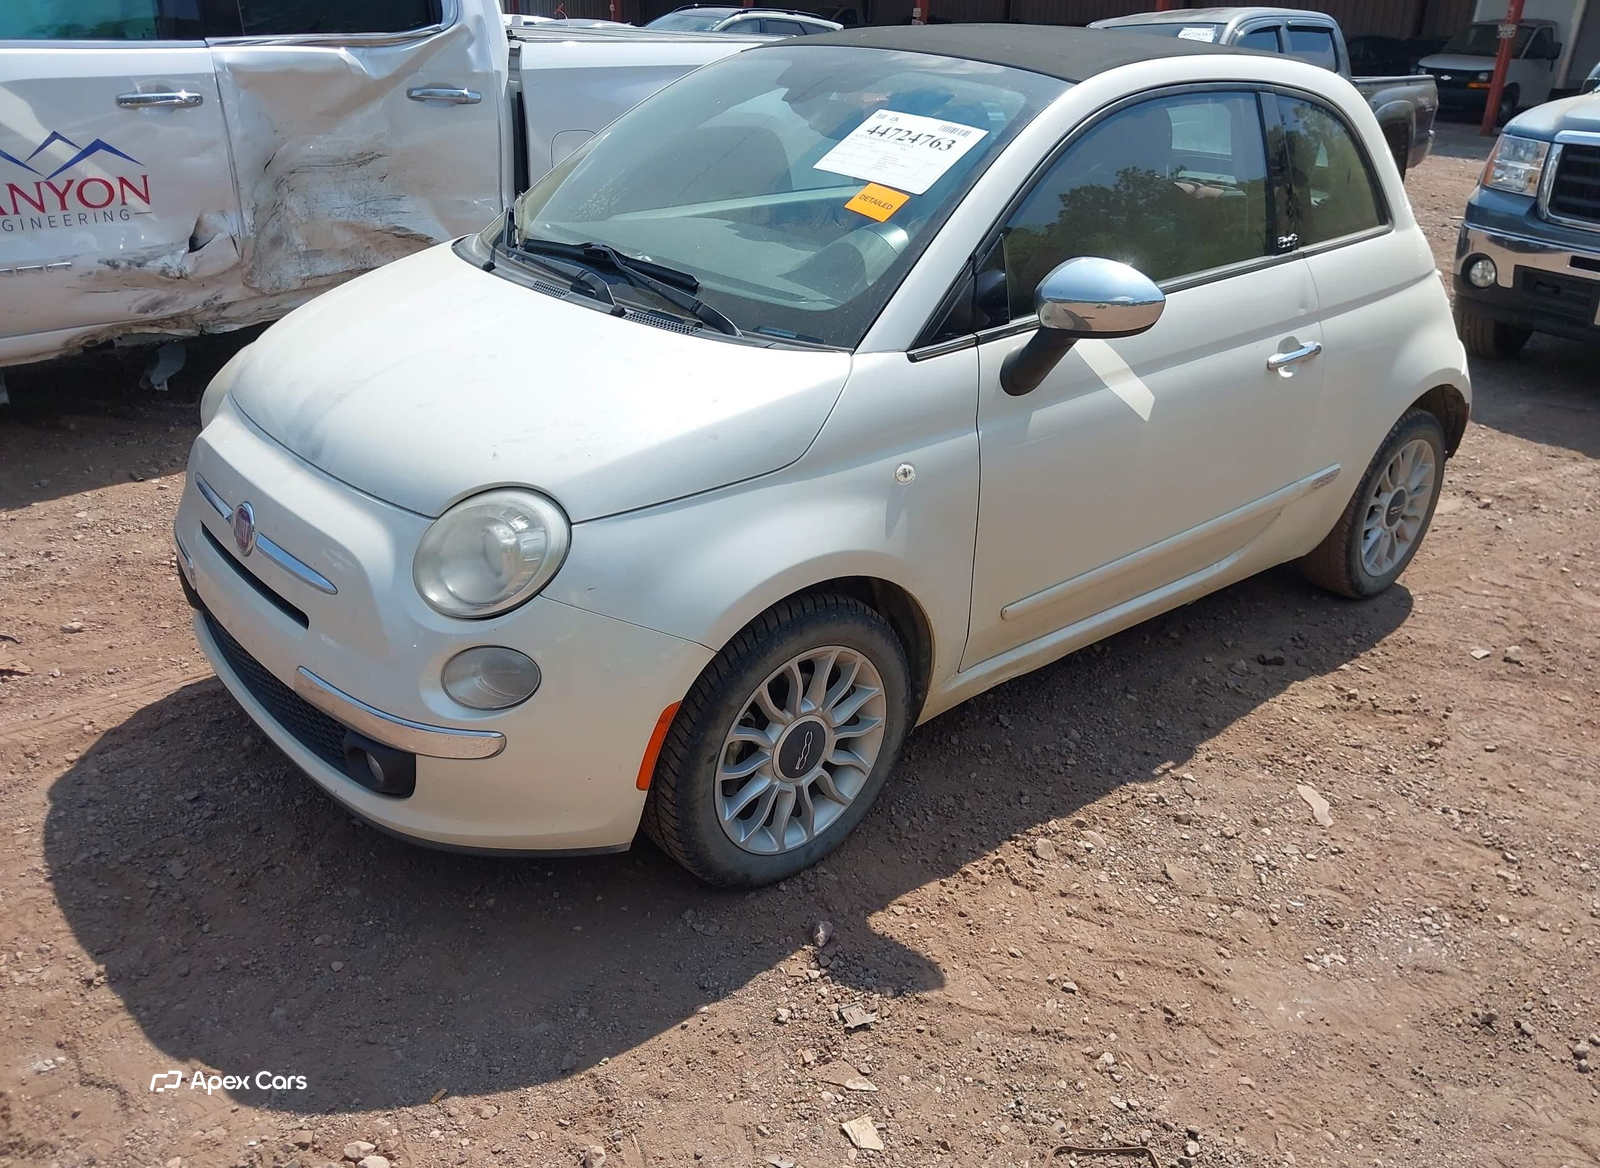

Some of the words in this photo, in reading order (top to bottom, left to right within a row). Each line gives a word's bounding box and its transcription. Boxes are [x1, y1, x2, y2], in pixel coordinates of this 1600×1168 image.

[866, 125, 957, 151] 44724763
[0, 175, 151, 216] NYON
[859, 194, 894, 211] DETAILED
